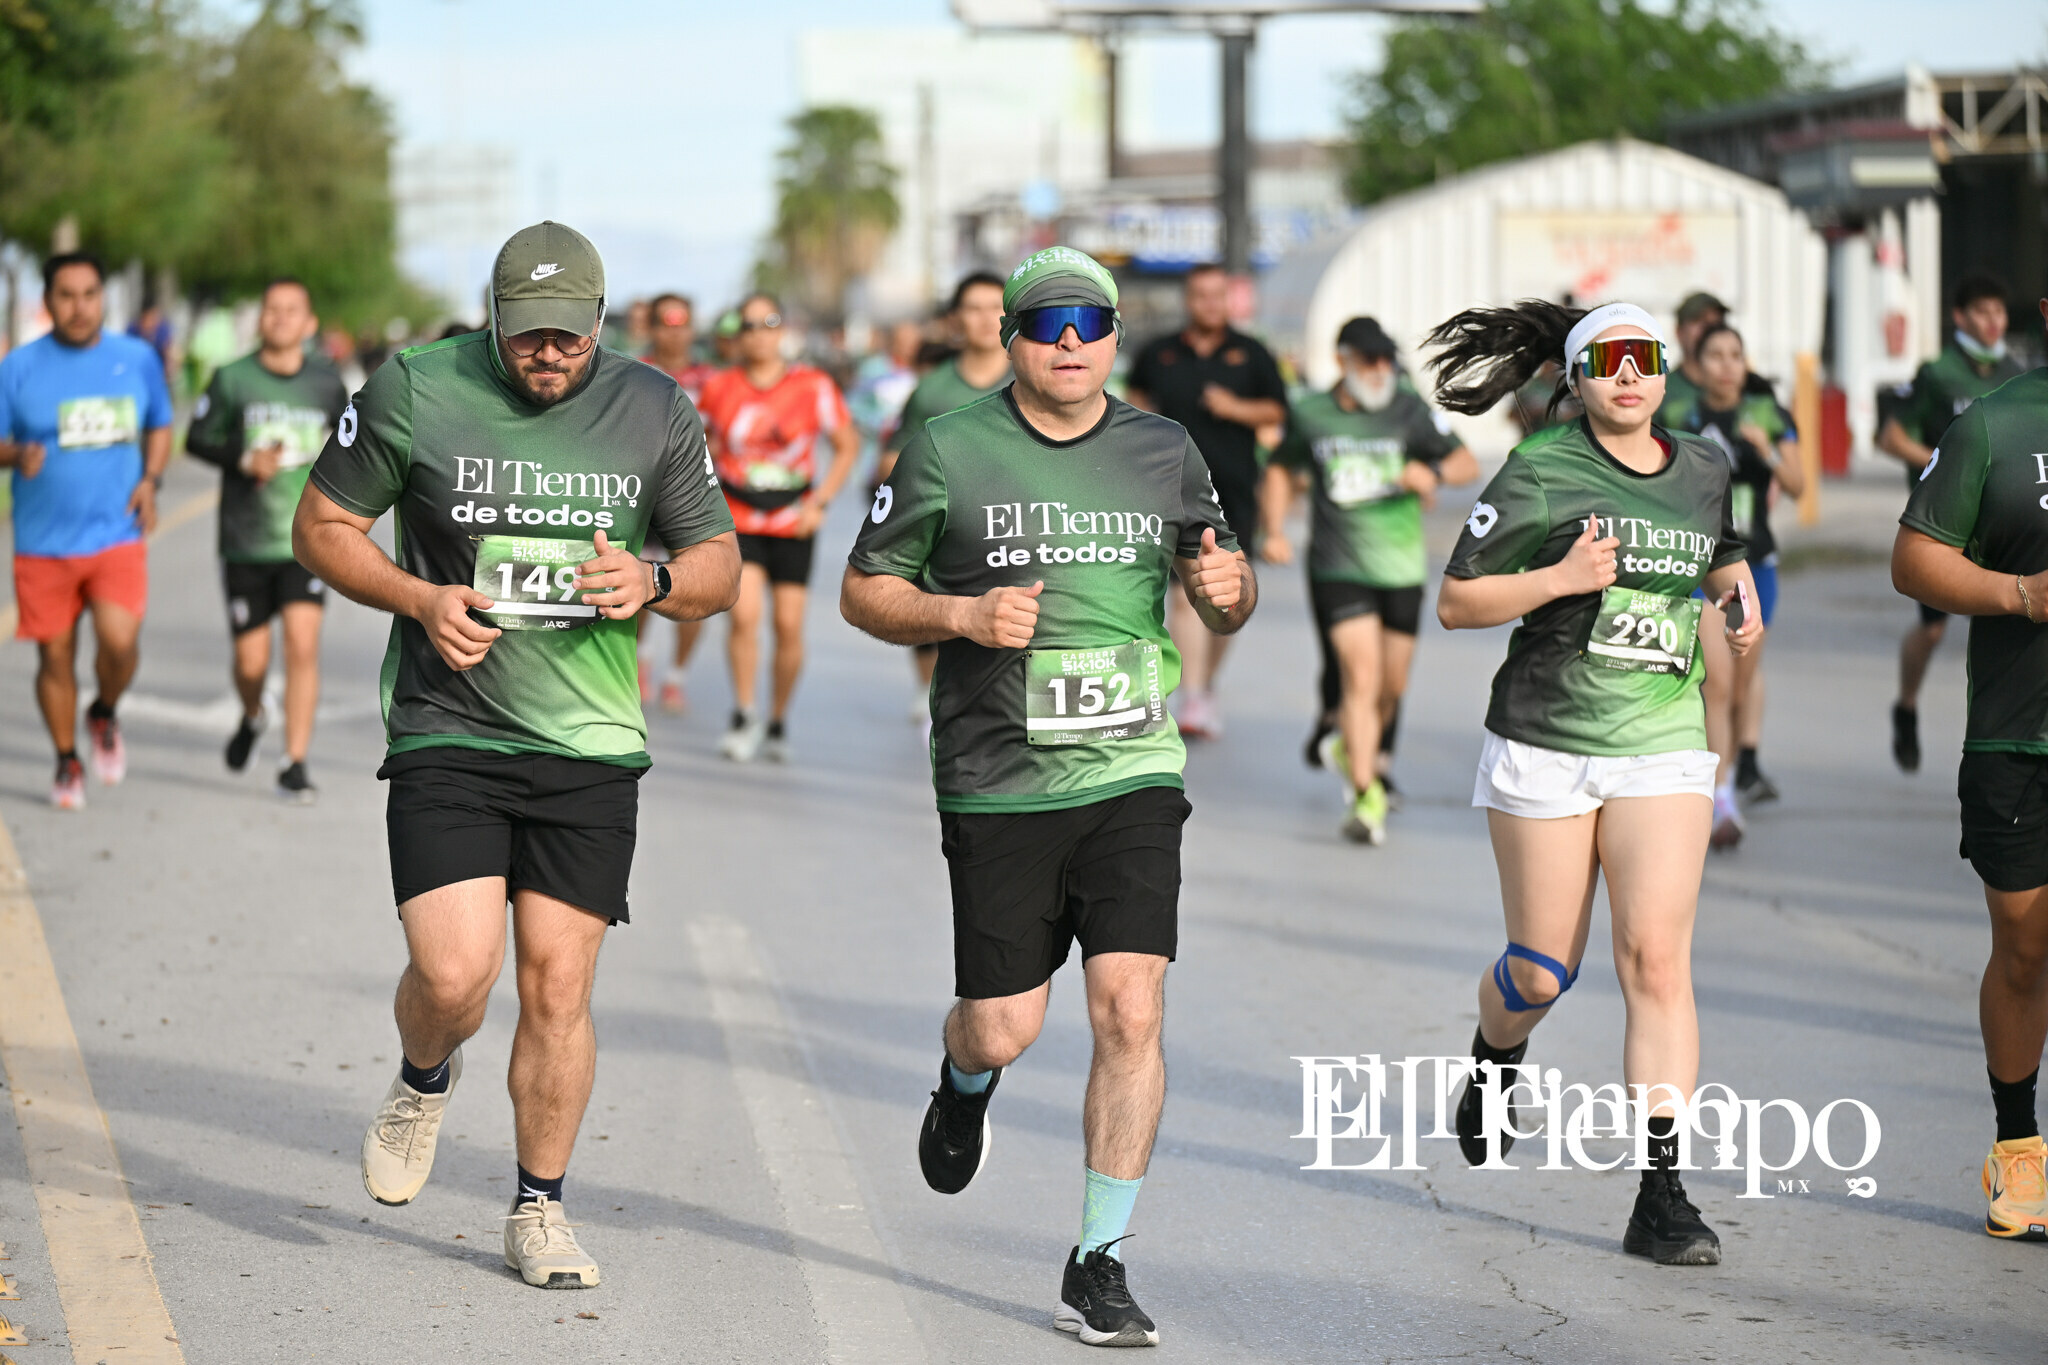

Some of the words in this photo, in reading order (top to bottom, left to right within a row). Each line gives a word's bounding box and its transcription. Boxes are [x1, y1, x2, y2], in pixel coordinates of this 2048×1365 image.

[536, 263, 558, 274] NIKE
[452, 456, 495, 494] El
[503, 460, 641, 508] Tiempo
[451, 500, 497, 524] de
[504, 503, 614, 528] todos
[612, 499, 621, 507] MX
[982, 502, 1025, 540] El
[1030, 502, 1163, 544] Tiempo
[512, 539, 567, 549] CARRERA
[1620, 517, 1716, 561] Tiempo
[986, 545, 1031, 568] de
[1036, 541, 1137, 564] todos
[1622, 553, 1699, 577] todos
[495, 562, 582, 602] 149
[1606, 613, 1678, 654] 290
[1061, 650, 1116, 661] CARRERA
[1143, 644, 1159, 653] 152
[1047, 672, 1131, 715] 152
[1147, 659, 1162, 721] MEDALLA
